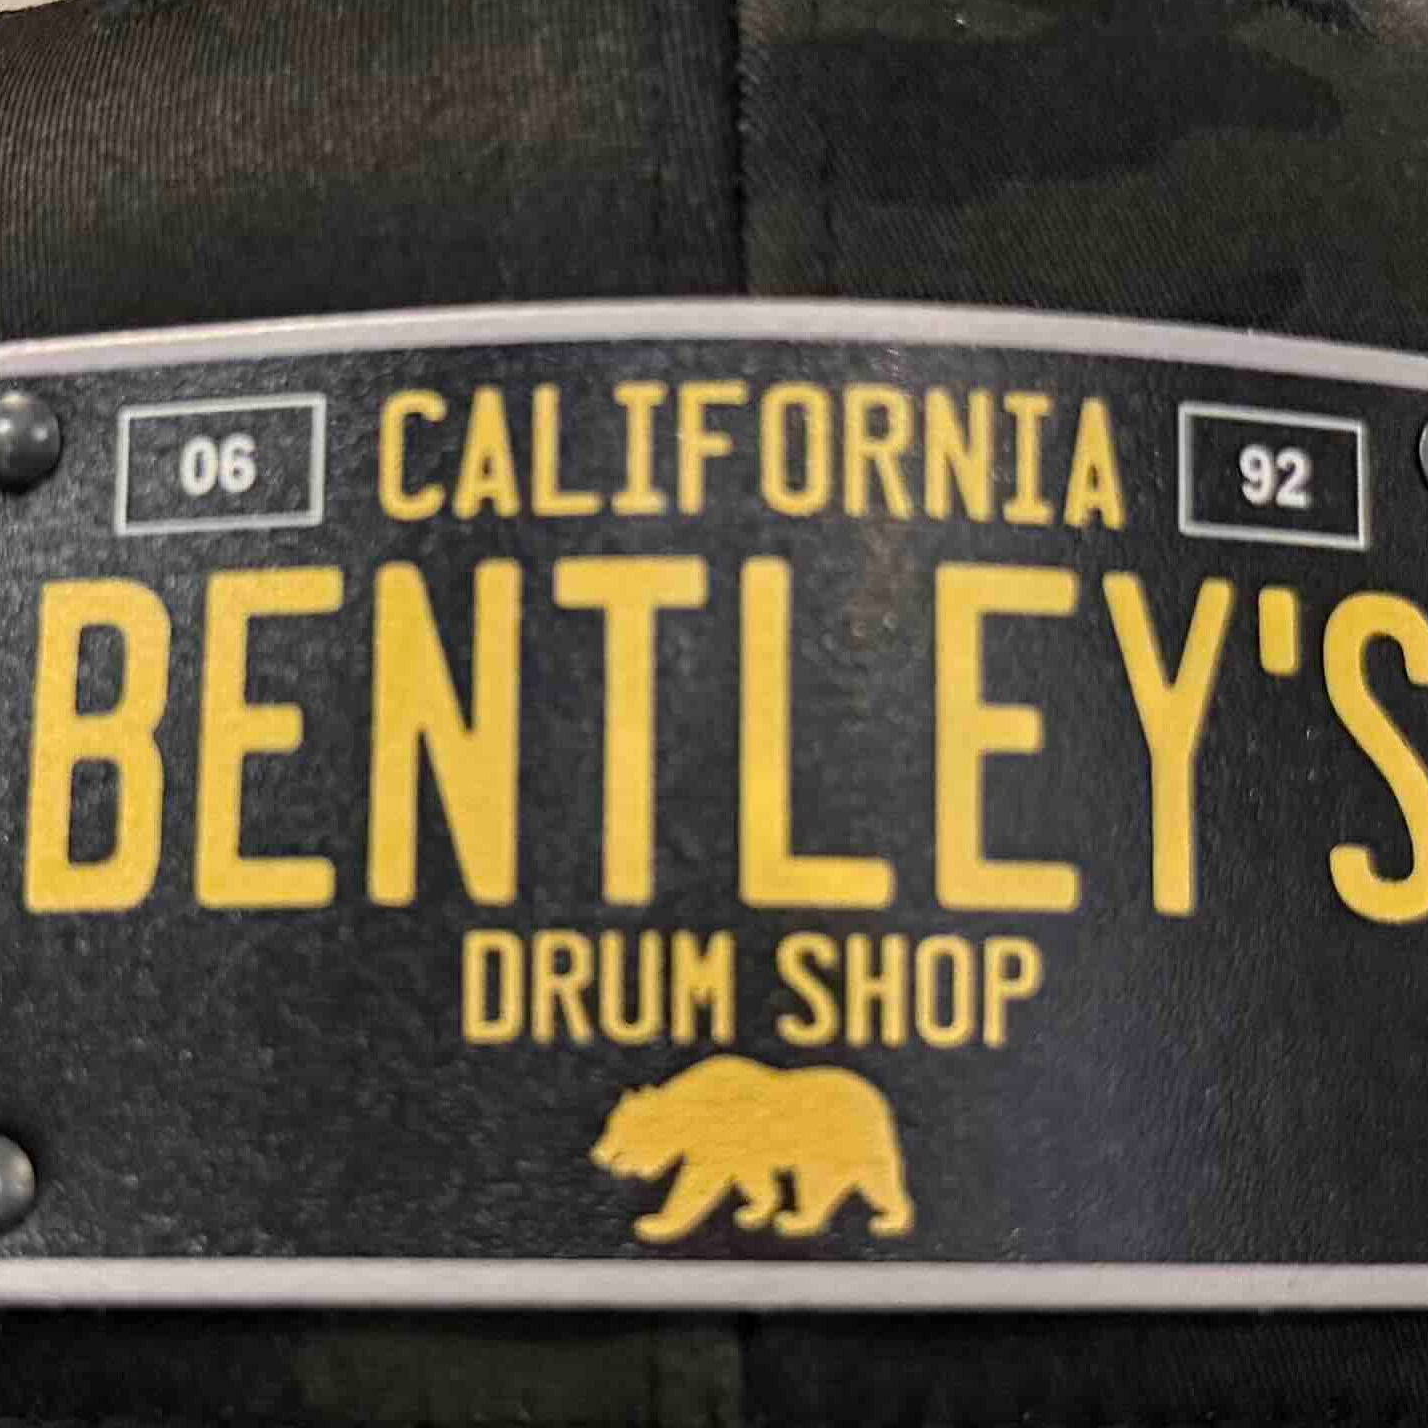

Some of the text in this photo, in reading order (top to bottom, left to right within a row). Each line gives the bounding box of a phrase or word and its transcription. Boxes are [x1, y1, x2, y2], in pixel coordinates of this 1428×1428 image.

[178, 432, 258, 497] 06
[380, 379, 1126, 529] CALIFORNIA
[1238, 444, 1310, 509] 92
[463, 930, 1042, 1047] DRUM SHOP
